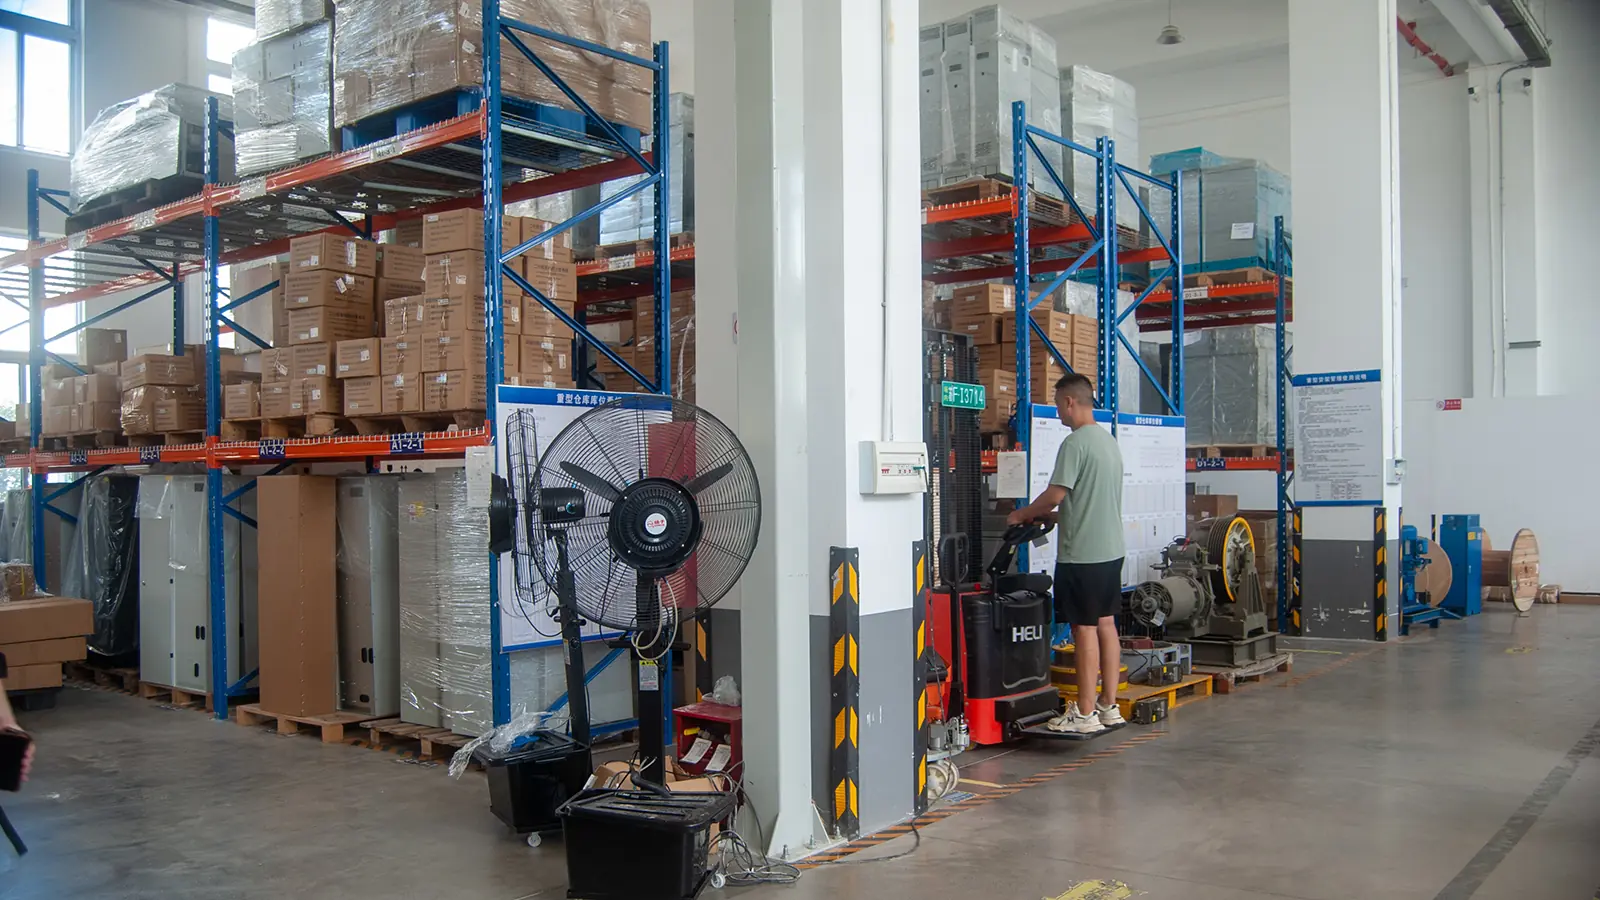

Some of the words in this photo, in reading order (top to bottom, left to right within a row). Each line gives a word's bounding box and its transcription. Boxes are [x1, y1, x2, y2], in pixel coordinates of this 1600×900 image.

[259, 445, 285, 455] A1-2-2
[391, 439, 423, 450] A1-2-1
[1012, 624, 1042, 642] HELI
